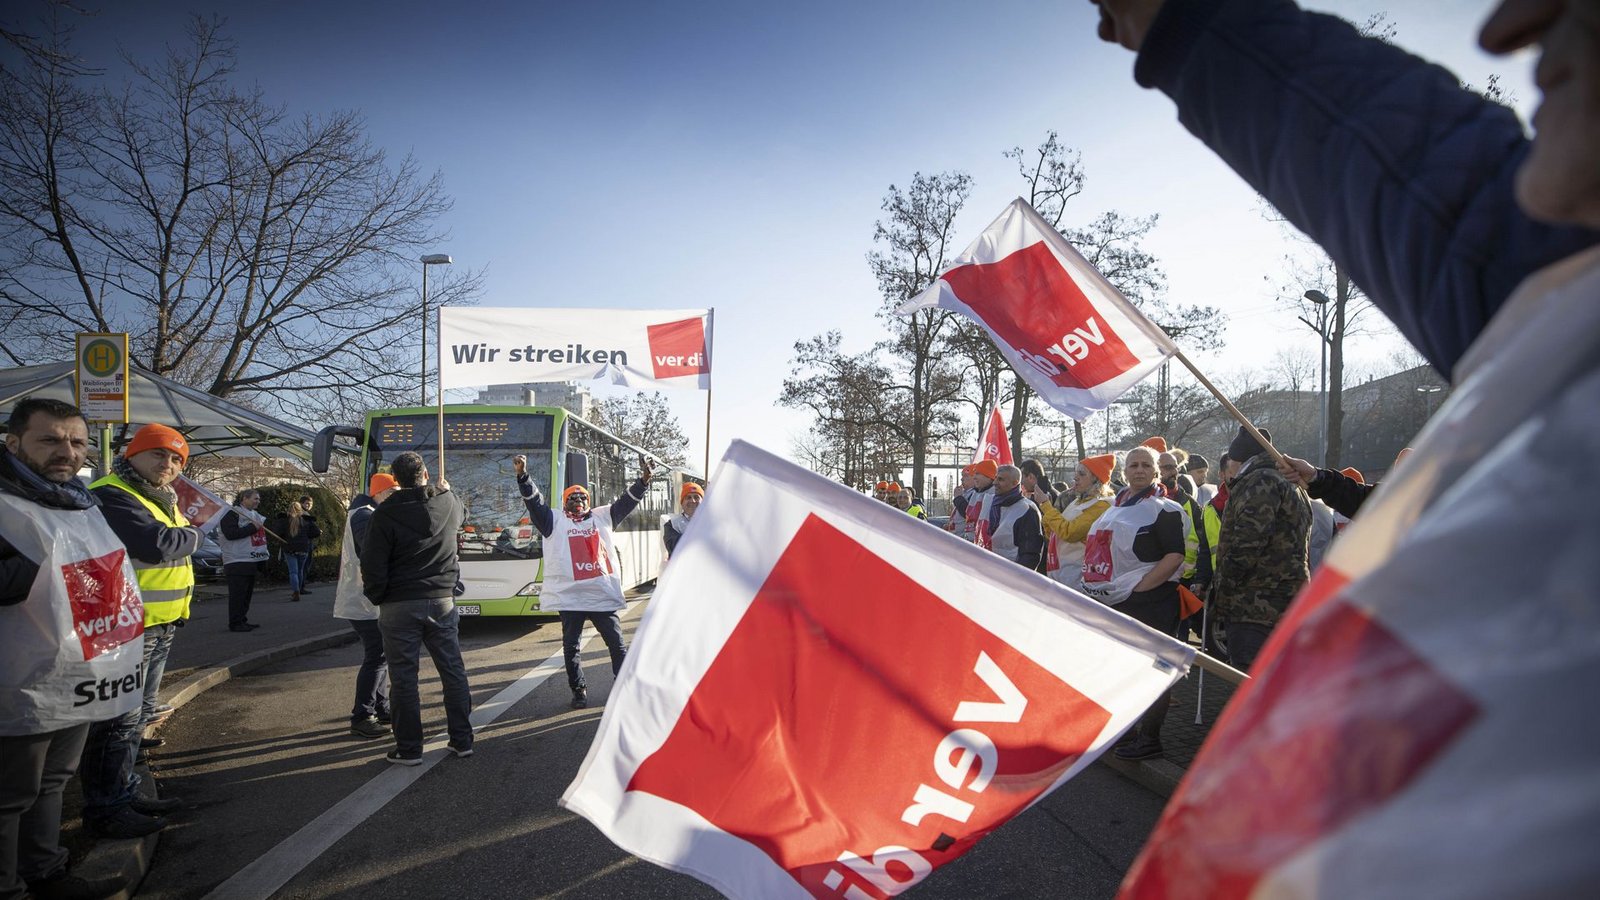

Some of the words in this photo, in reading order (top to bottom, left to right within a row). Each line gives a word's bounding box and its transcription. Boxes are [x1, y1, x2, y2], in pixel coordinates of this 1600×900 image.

[451, 343, 501, 364] Wir
[508, 344, 628, 366] streiken
[655, 352, 704, 367] ver.di
[465, 606, 480, 614] 505
[79, 603, 142, 637] ver.di
